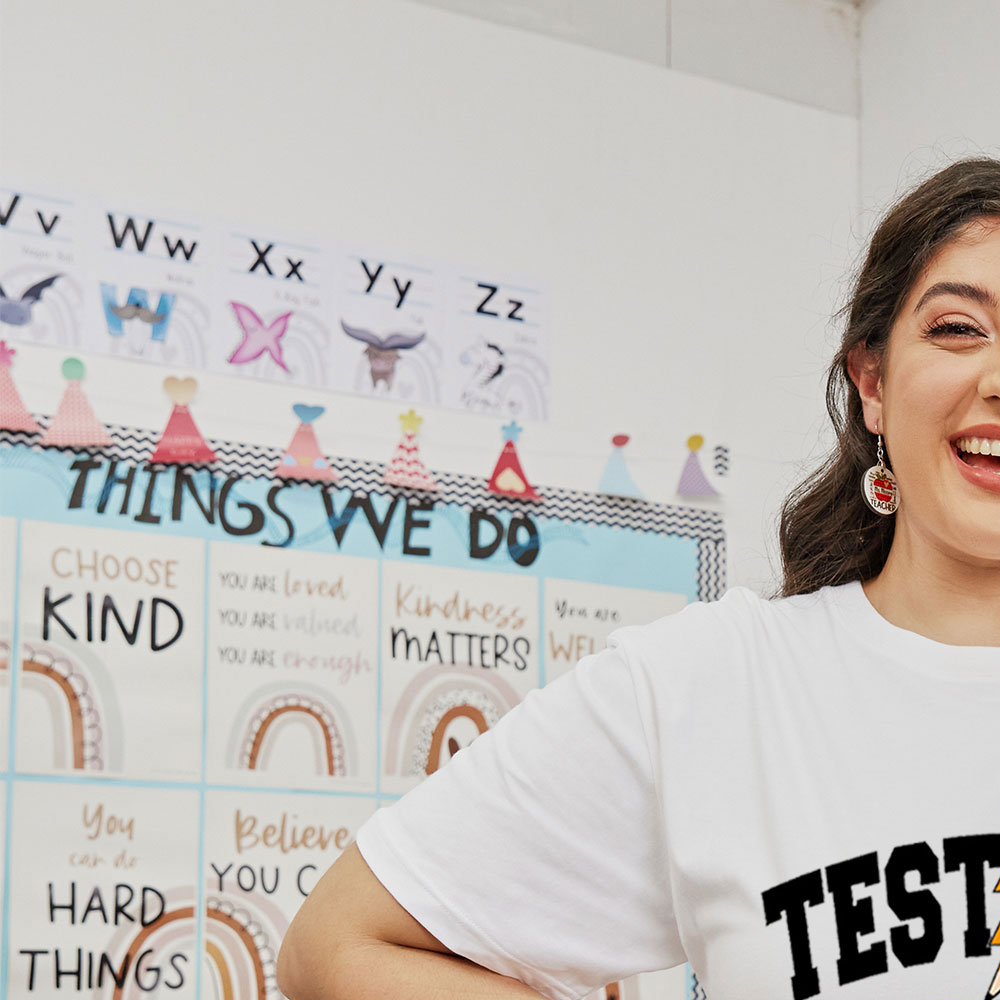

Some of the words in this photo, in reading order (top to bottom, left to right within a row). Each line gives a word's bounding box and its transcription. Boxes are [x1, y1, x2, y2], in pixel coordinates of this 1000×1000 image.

[68, 460, 295, 548] THINGS
[321, 487, 435, 557] WE
[469, 508, 541, 567] DO
[50, 547, 179, 590] CHOOSE
[219, 572, 248, 590] YOU
[252, 574, 277, 593] ARE
[42, 586, 184, 652] KIND
[218, 608, 247, 627] YOU
[252, 611, 277, 630] ARE
[394, 582, 528, 630] Kindness
[217, 646, 247, 665] YOU
[252, 649, 276, 668] ARE
[84, 804, 135, 841] You
[235, 808, 349, 854] Believe
[211, 863, 279, 895] YOU
[48, 882, 166, 928] HARD
[19, 948, 189, 992] THINGS
